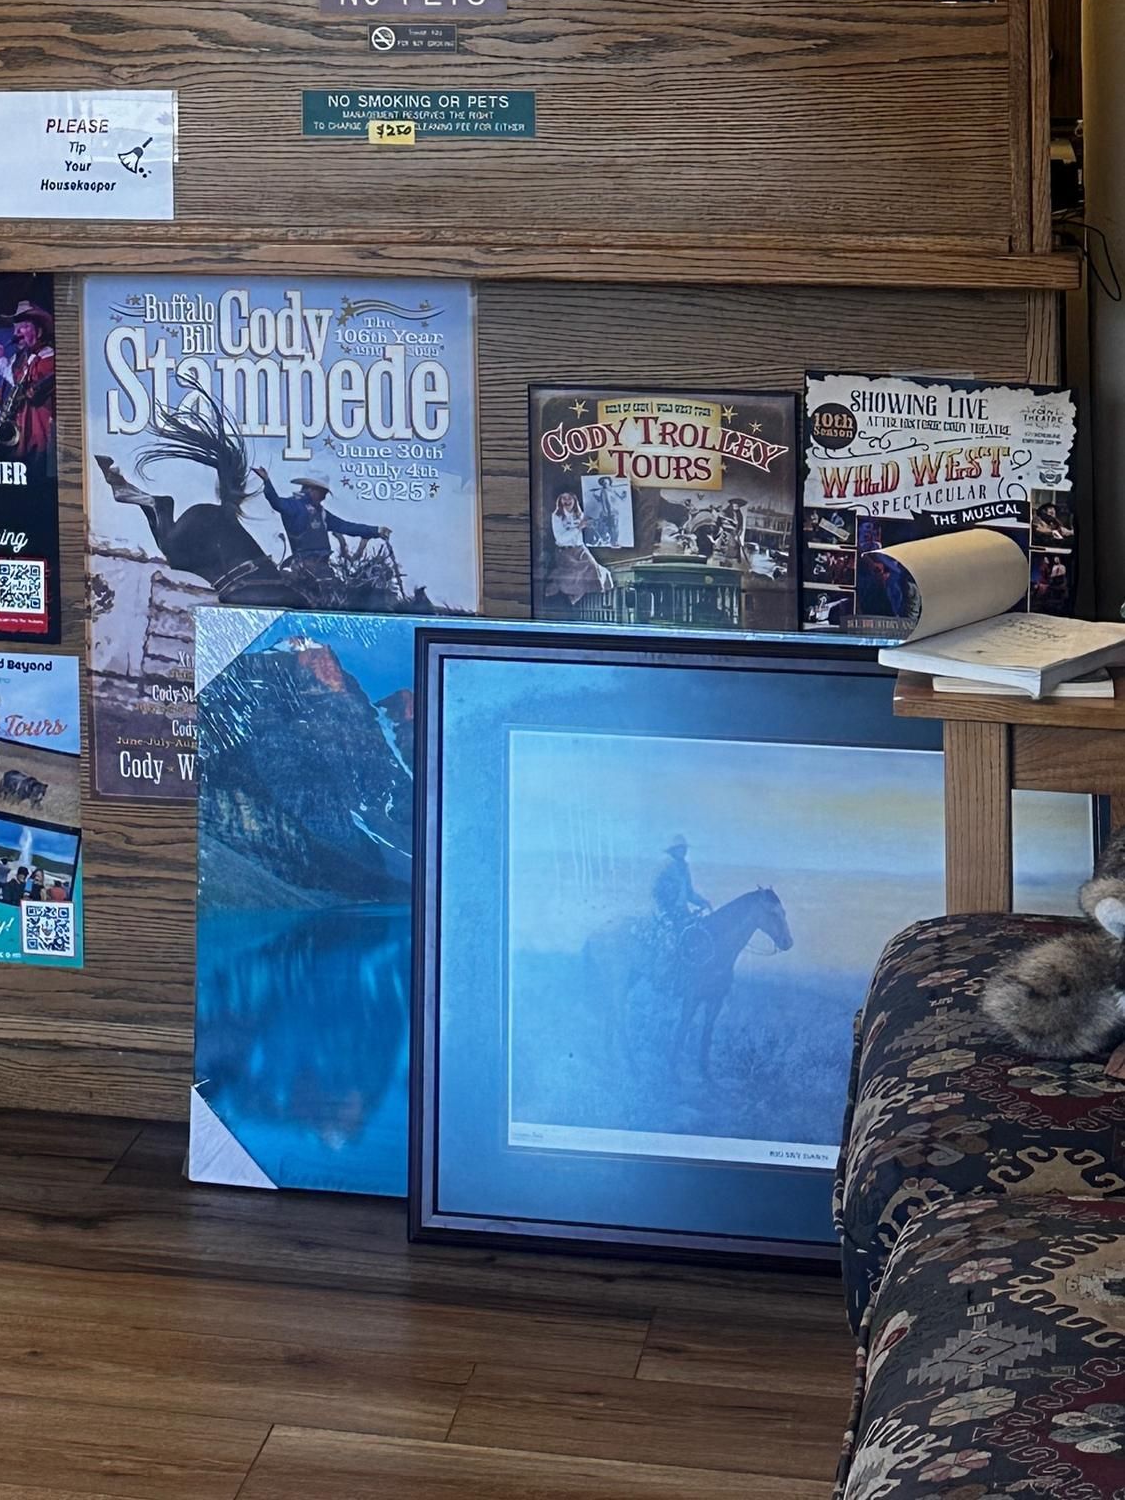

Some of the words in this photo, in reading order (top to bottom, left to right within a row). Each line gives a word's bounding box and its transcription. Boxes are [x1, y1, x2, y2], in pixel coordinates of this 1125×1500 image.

[328, 95, 350, 108] NO
[358, 95, 431, 108] SMOKING
[439, 95, 460, 108] OR
[467, 96, 509, 108] PETS
[342, 110, 399, 119] MANAGEMENT
[402, 111, 445, 120] RESERVES
[449, 111, 466, 120] THE
[469, 111, 494, 120] RIGHT
[46, 119, 110, 133] PLEASE
[314, 121, 325, 130] TO
[328, 121, 361, 130] CHARGE
[455, 122, 471, 131] FEE
[474, 123, 491, 131] FOR
[495, 123, 525, 131] EITHER
[376, 124, 412, 138] $250
[69, 141, 87, 154] Tip
[64, 160, 92, 172] Your
[41, 179, 117, 193] Housekeeper
[144, 293, 214, 323] Buffalo
[219, 289, 333, 364] Cody
[364, 317, 395, 329] The
[182, 324, 216, 354] Bill
[334, 329, 387, 344] 106th
[392, 329, 444, 344] Year
[105, 326, 449, 460] Stampede
[850, 390, 937, 416] SHOWING
[947, 397, 989, 420] LIVE
[814, 412, 854, 429] 10th
[970, 422, 1011, 436] THEATRE
[813, 427, 853, 438] Season
[337, 443, 392, 459] June
[397, 444, 443, 459] 30th
[542, 417, 628, 462] CODY
[633, 416, 789, 473] TROLLEY
[354, 462, 401, 481] July
[404, 463, 439, 478] 4th
[609, 450, 711, 482] TOURS
[818, 460, 900, 498] WILD
[908, 447, 1011, 487] WEST
[356, 480, 425, 501] 2025
[872, 485, 987, 516] SPECTACULAR
[931, 513, 965, 527] THE
[968, 504, 1021, 522] MUSICAL
[7, 660, 52, 673] Beyond
[5, 714, 68, 738] Tours
[120, 751, 163, 784] Cody
